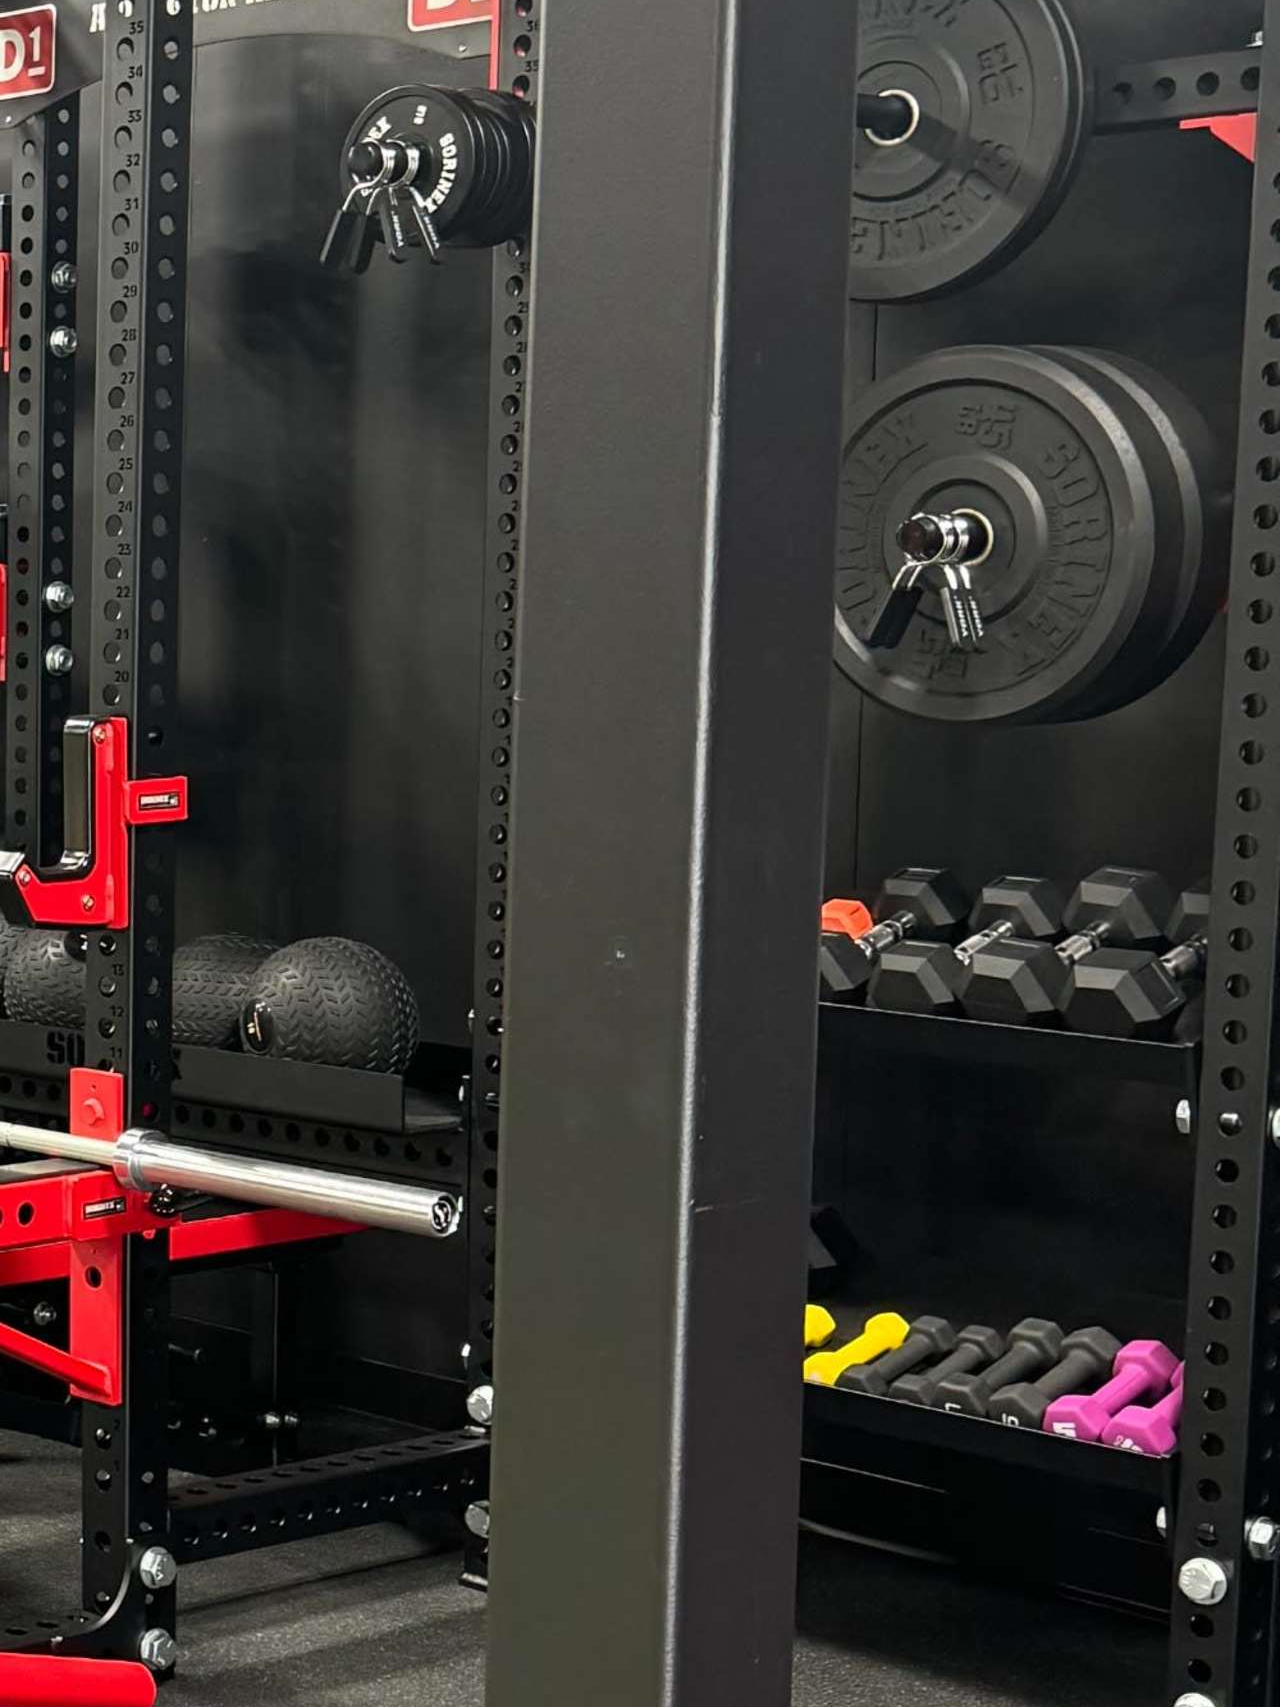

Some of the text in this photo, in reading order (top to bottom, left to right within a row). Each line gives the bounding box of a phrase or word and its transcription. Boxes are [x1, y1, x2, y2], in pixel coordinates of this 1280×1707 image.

[130, 20, 144, 34] 35
[128, 65, 142, 78] 34
[128, 110, 141, 123] 33
[127, 153, 140, 167] 32
[424, 132, 458, 214] SORINEX
[125, 198, 138, 211] 31
[124, 242, 138, 255] 30
[123, 285, 137, 298] 29
[122, 329, 136, 341] 28
[121, 372, 135, 384] 27
[120, 415, 134, 427] 26
[119, 458, 133, 470] 25
[118, 501, 132, 515] 24
[118, 543, 131, 555] 23
[117, 586, 133, 598] 22
[116, 628, 129, 640] 21
[115, 671, 129, 682] 20
[110, 1005, 124, 1017] 12
[110, 1047, 122, 1058] 11
